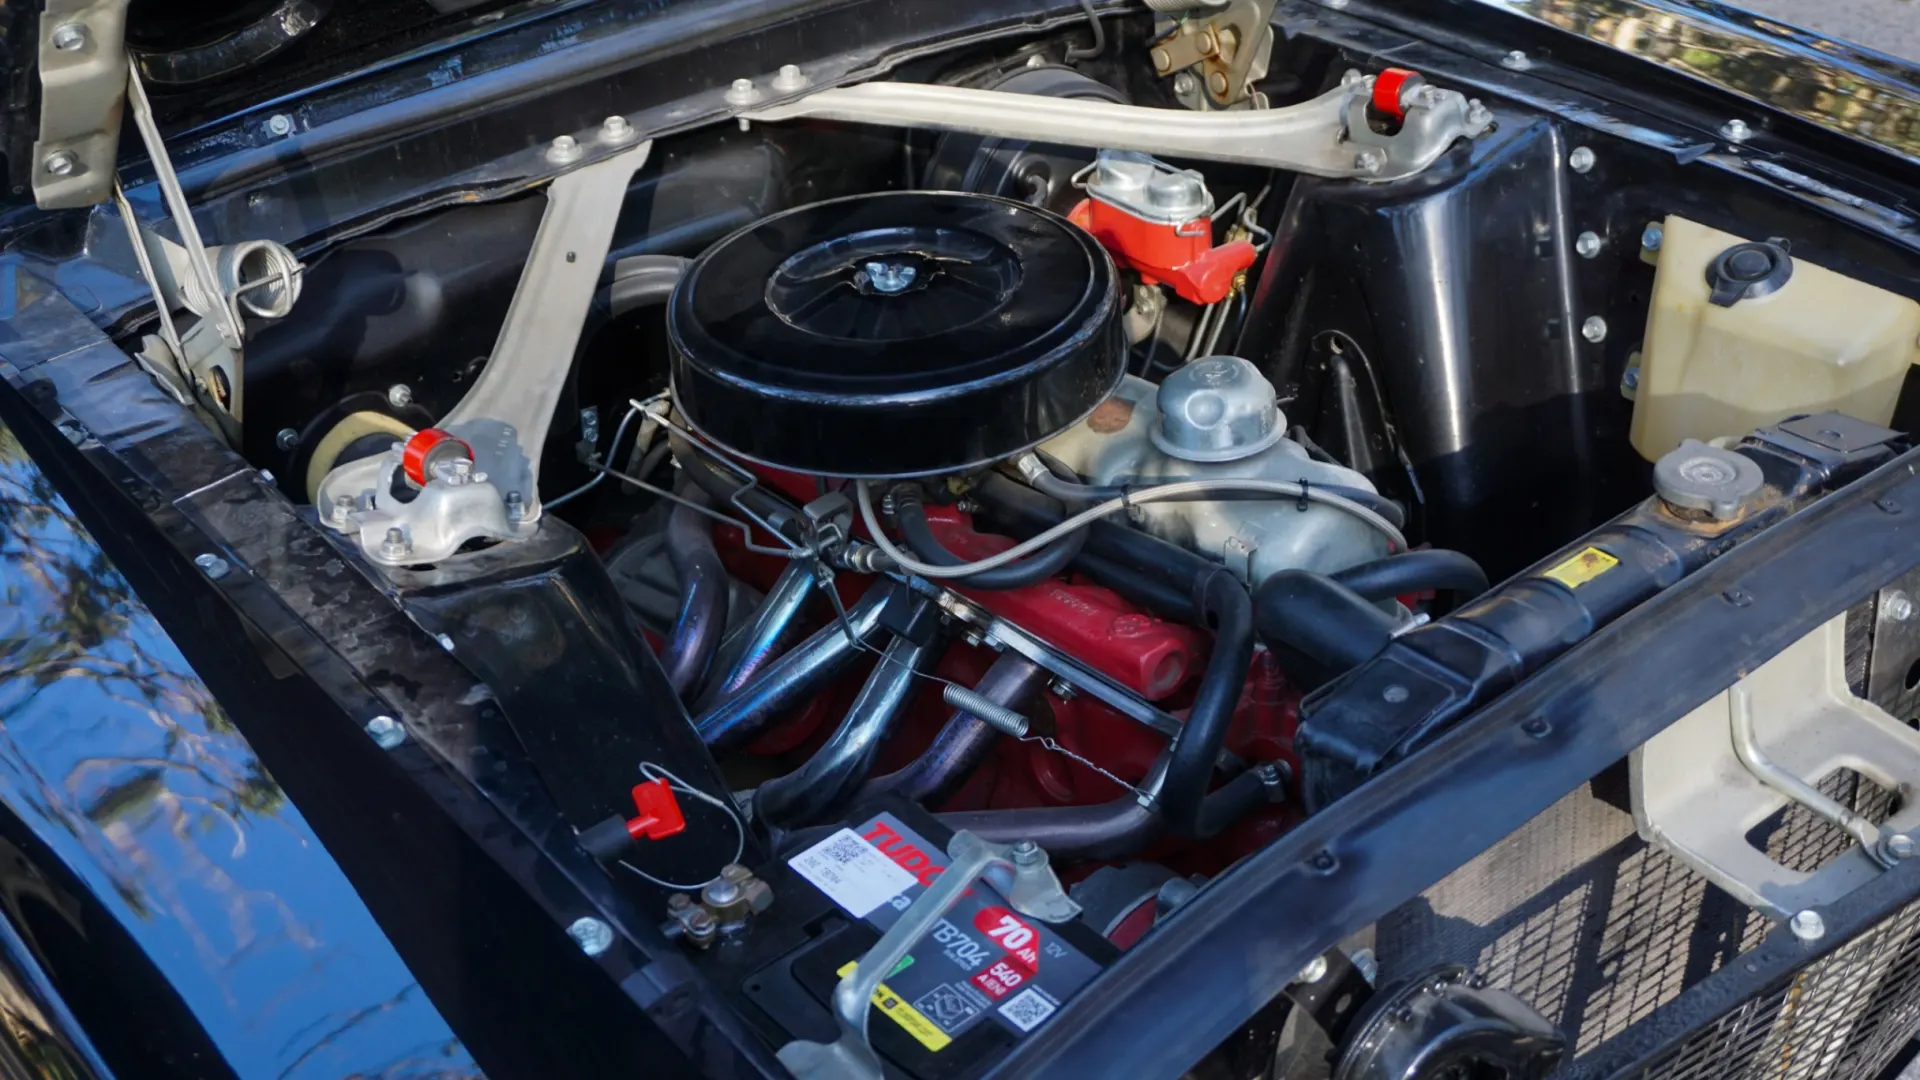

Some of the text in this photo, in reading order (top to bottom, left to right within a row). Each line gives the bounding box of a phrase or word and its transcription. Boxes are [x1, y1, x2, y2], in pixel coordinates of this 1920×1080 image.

[862, 821, 972, 909] TUDO
[931, 918, 990, 967] TB704
[988, 914, 1037, 964] 70 Ah
[989, 962, 1022, 987] 540
